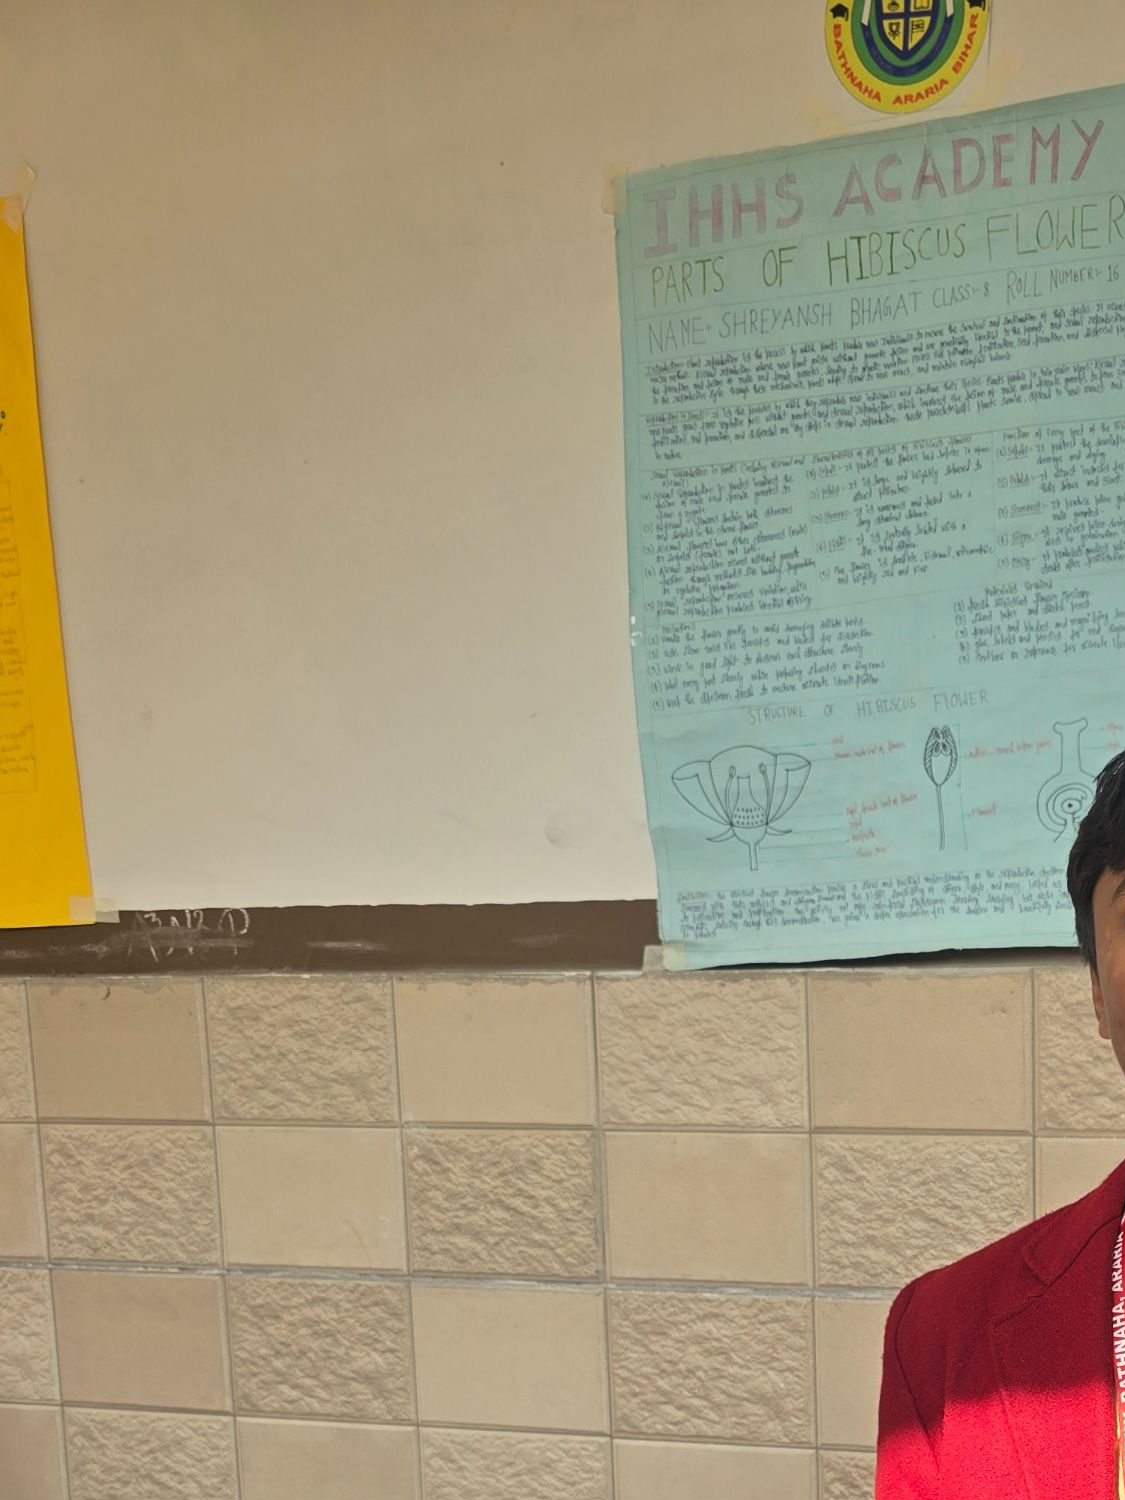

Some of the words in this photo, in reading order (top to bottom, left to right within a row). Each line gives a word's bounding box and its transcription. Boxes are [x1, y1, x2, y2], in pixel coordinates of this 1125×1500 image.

[833, 24, 882, 102] BATHNAHA
[892, 78, 949, 105] ARARIA
[952, 12, 979, 74] BIHAR
[643, 174, 804, 260] IHHS
[832, 119, 1104, 219] ACADEMY
[652, 257, 726, 307] PARTS
[762, 246, 798, 288] OF
[827, 222, 966, 288] HIBISCUS
[718, 302, 832, 339] SHREYANSH
[850, 291, 922, 330] BHAGAT
[1007, 270, 1043, 305] ROLL
[1107, 264, 1120, 283] 16
[748, 703, 806, 726] STRUCTURE
[823, 705, 833, 718] OF
[856, 695, 916, 719] HIBISCUS
